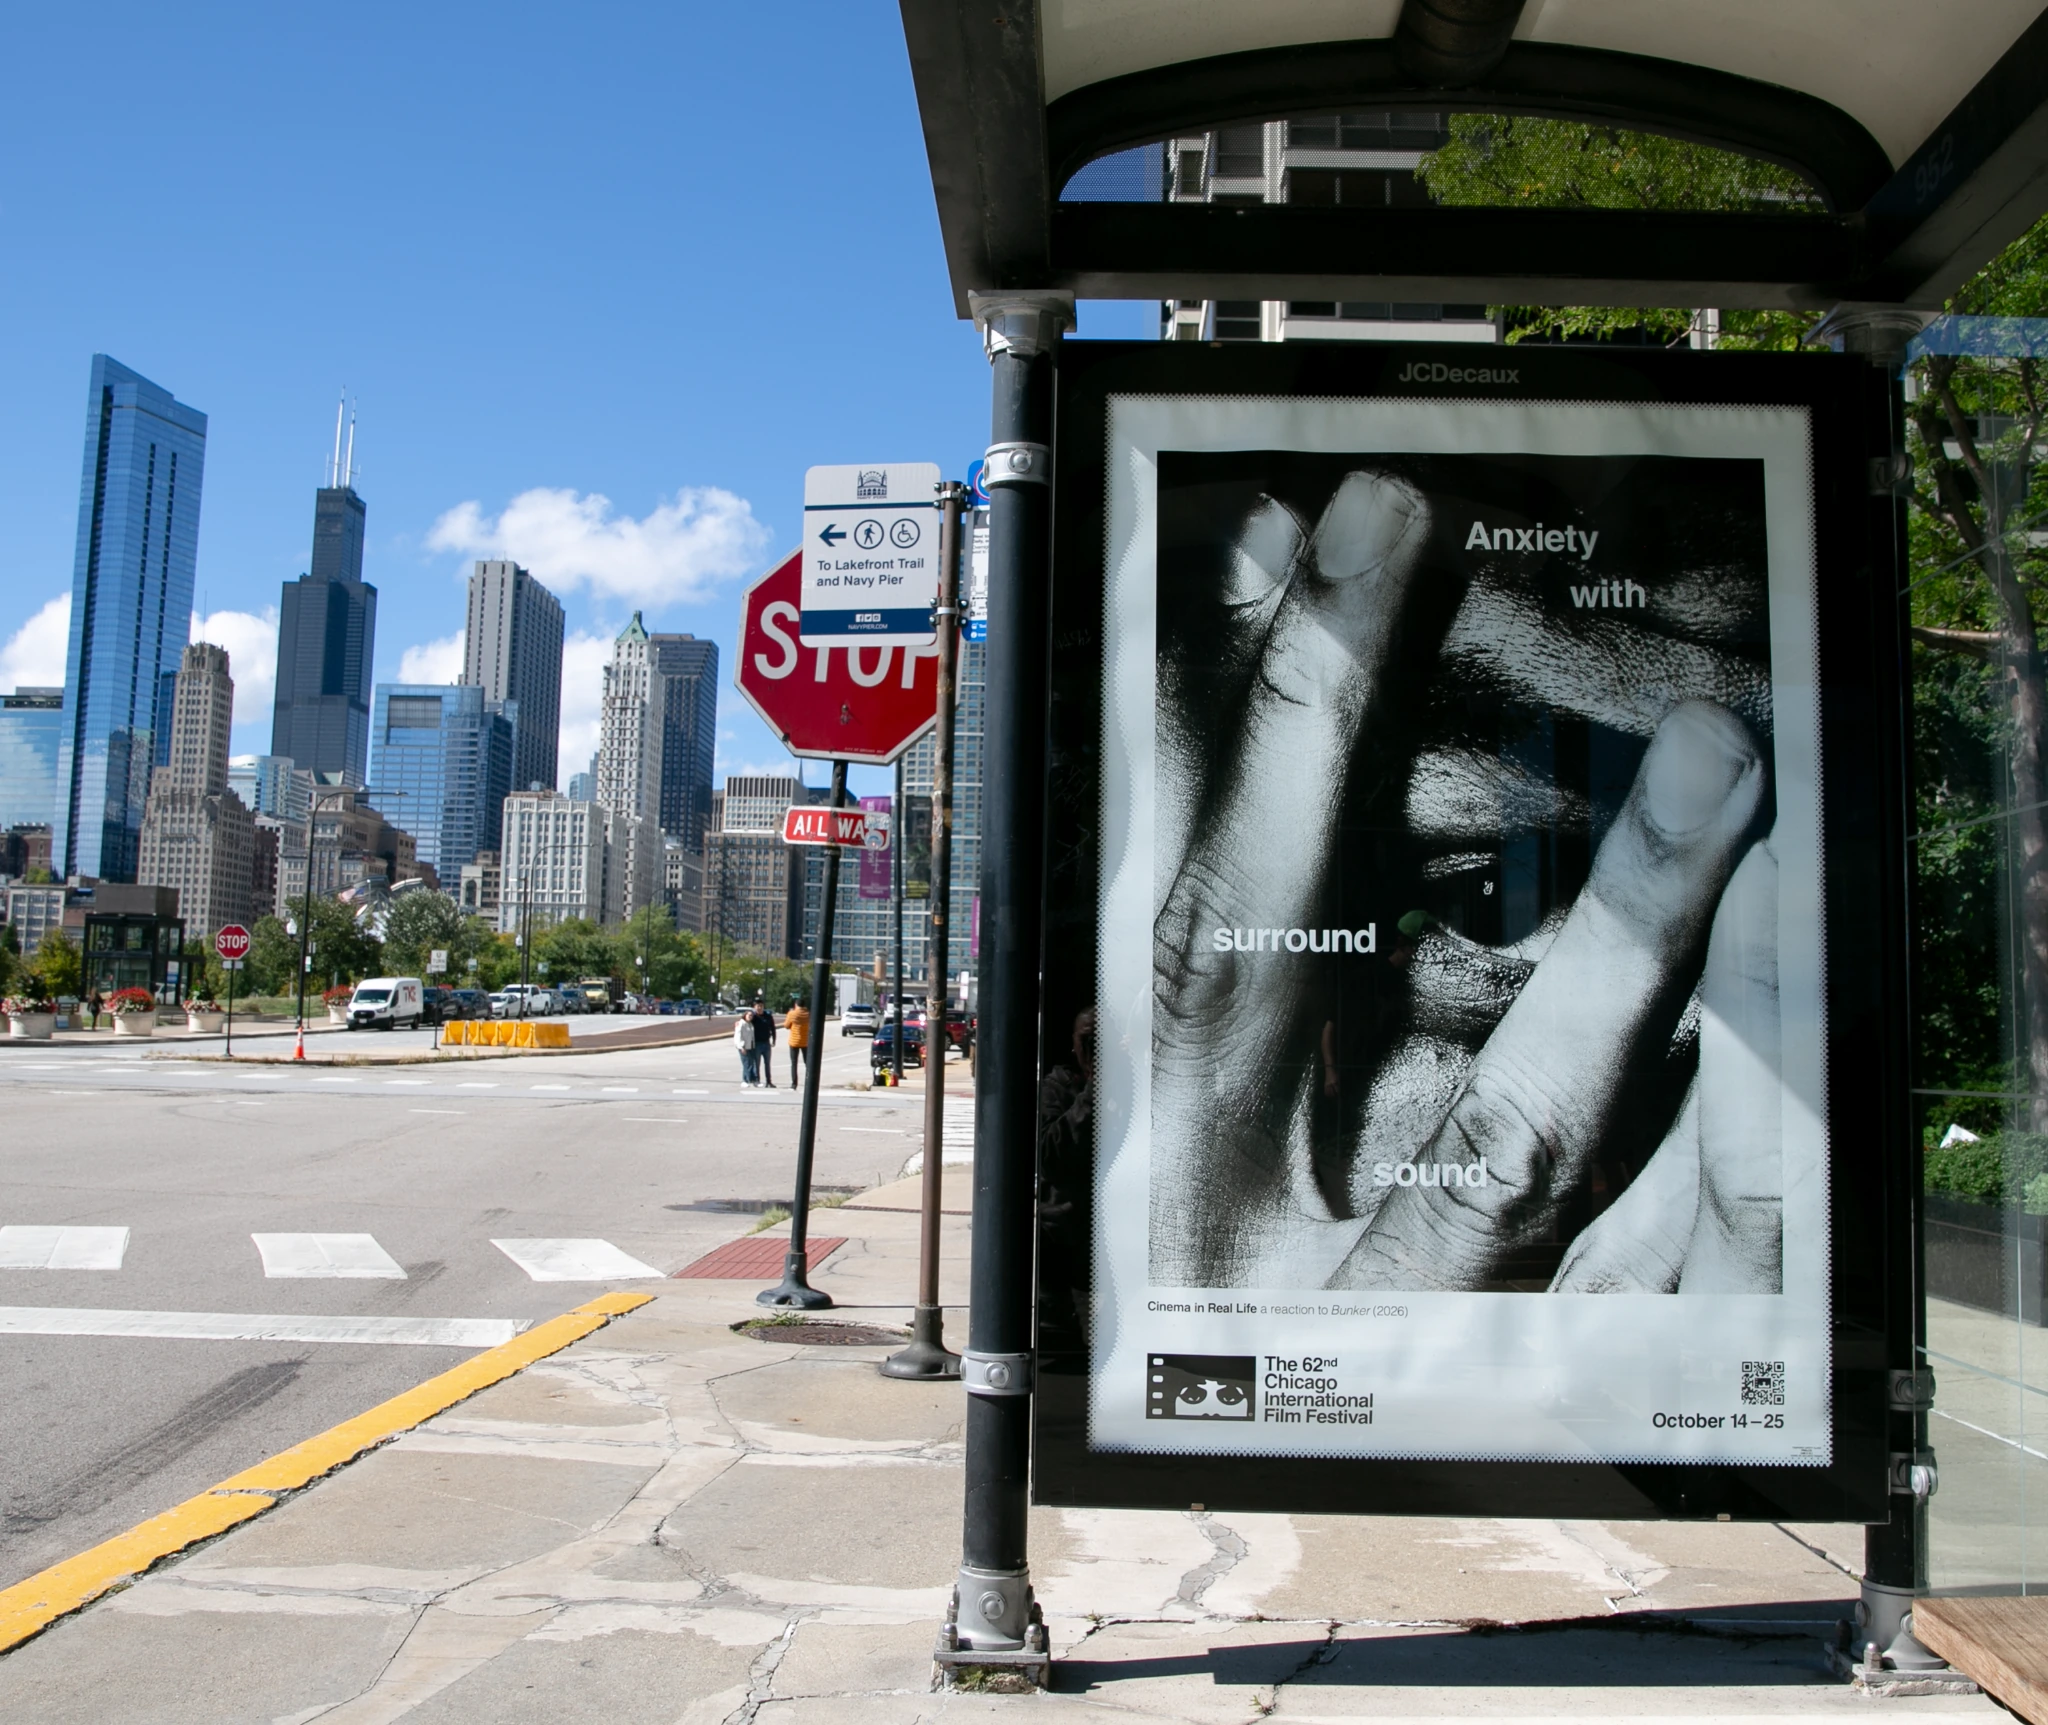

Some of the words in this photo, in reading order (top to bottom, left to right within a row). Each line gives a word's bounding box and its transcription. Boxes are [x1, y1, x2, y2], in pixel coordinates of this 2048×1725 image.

[1399, 362, 1520, 384] JCDecaux
[1465, 521, 1599, 560] Anxiety
[817, 560, 831, 571] To
[835, 559, 894, 571] Lakefront
[898, 558, 925, 569] Trail
[817, 576, 840, 587] and
[844, 575, 875, 588] Navy
[879, 574, 904, 585] Pier
[1570, 578, 1646, 608] with
[793, 815, 828, 837] ALL
[838, 817, 866, 839] WA
[218, 935, 248, 949] STOP
[1212, 922, 1376, 953] surround
[1373, 1156, 1487, 1187] sound
[1147, 1301, 1191, 1313] Cinema
[1194, 1302, 1205, 1313] in
[1208, 1303, 1233, 1314] Real
[1236, 1303, 1257, 1314] Life
[1260, 1306, 1267, 1314] a
[1270, 1304, 1315, 1315] reaction
[1318, 1305, 1328, 1316] to
[1331, 1305, 1370, 1316] Bunker
[1373, 1305, 1409, 1318] (2026)
[1264, 1356, 1298, 1372] The
[1302, 1357, 1338, 1372] 62nd
[1264, 1373, 1338, 1393] Chicago
[1264, 1391, 1374, 1408] International
[1264, 1409, 1301, 1423] Film
[1306, 1409, 1373, 1425] Festival
[1652, 1412, 1725, 1429] October
